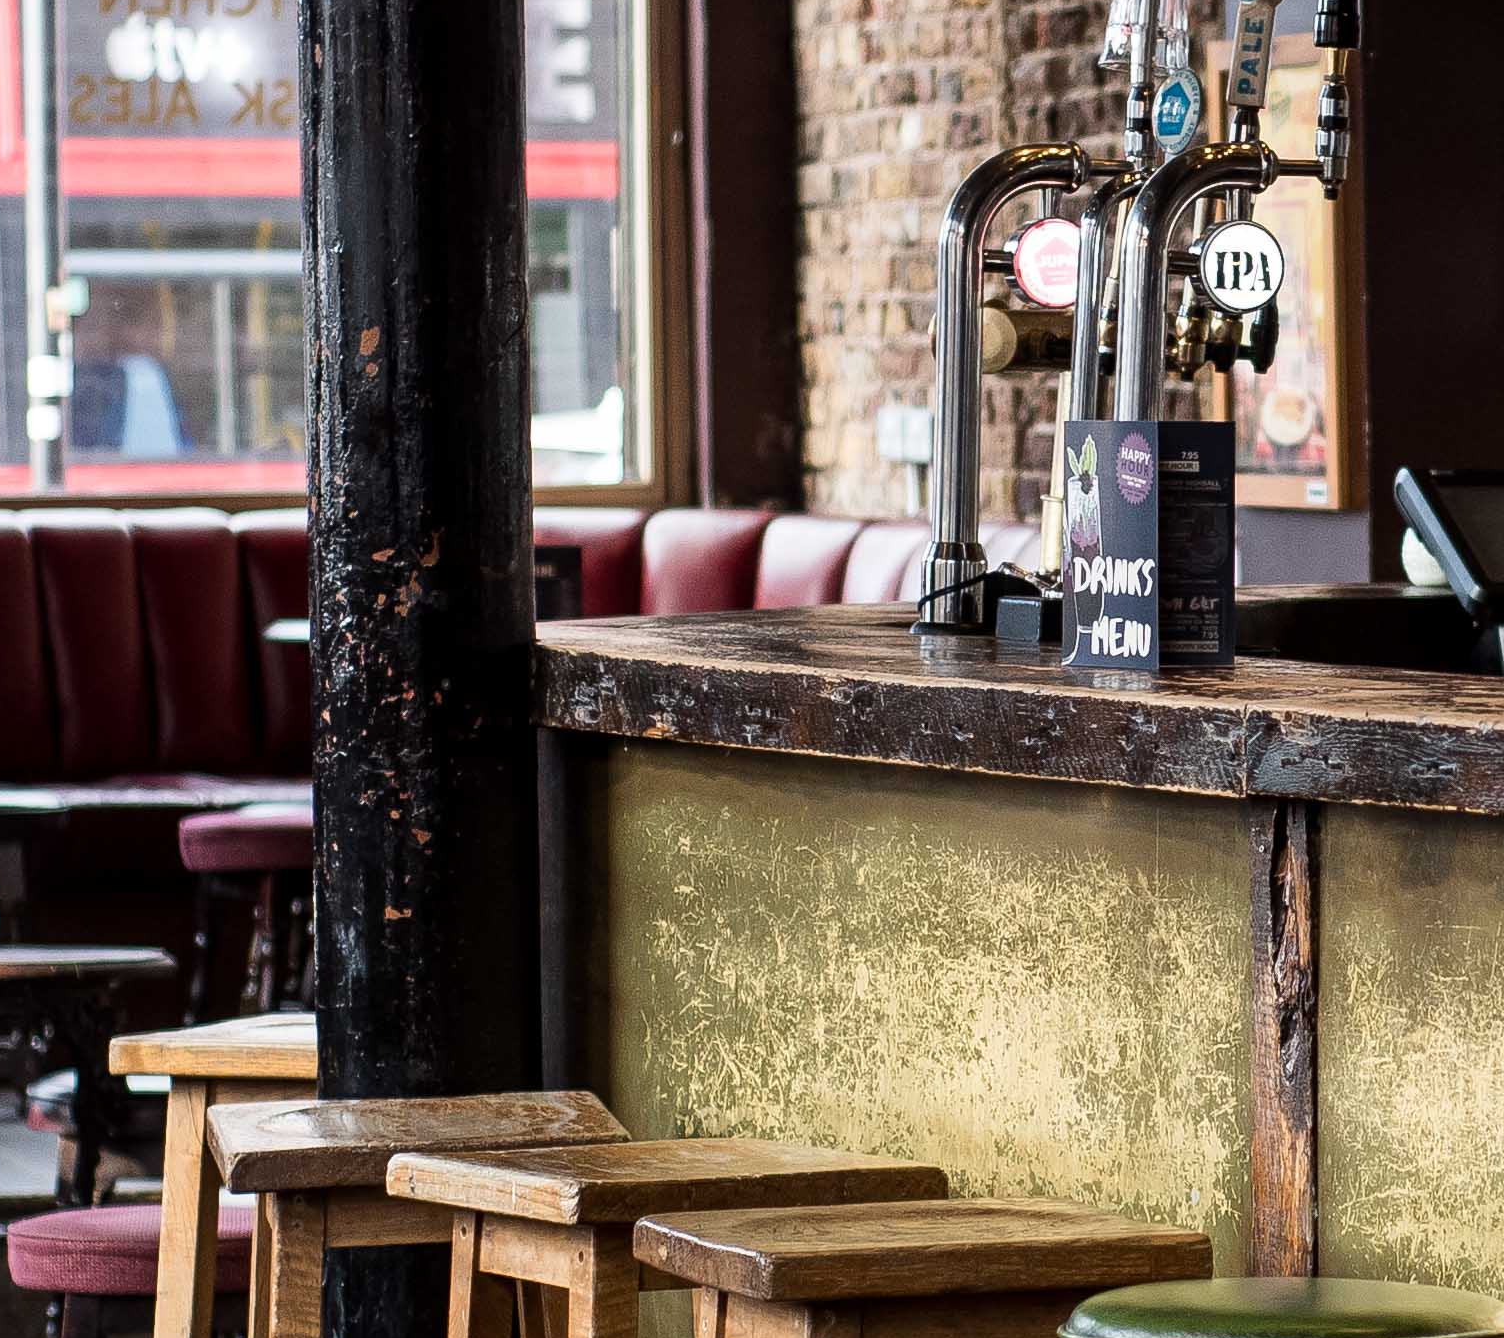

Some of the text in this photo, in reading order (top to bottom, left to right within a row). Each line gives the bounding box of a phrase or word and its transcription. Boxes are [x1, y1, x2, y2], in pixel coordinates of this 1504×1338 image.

[1236, 17, 1265, 96] PALE
[1213, 251, 1273, 292] IPA
[1120, 461, 1150, 477] HOUR
[1121, 447, 1151, 466] HAPPY
[1181, 451, 1200, 461] 7.95
[1073, 555, 1156, 597] DRINKS
[1091, 615, 1151, 658] MENU
